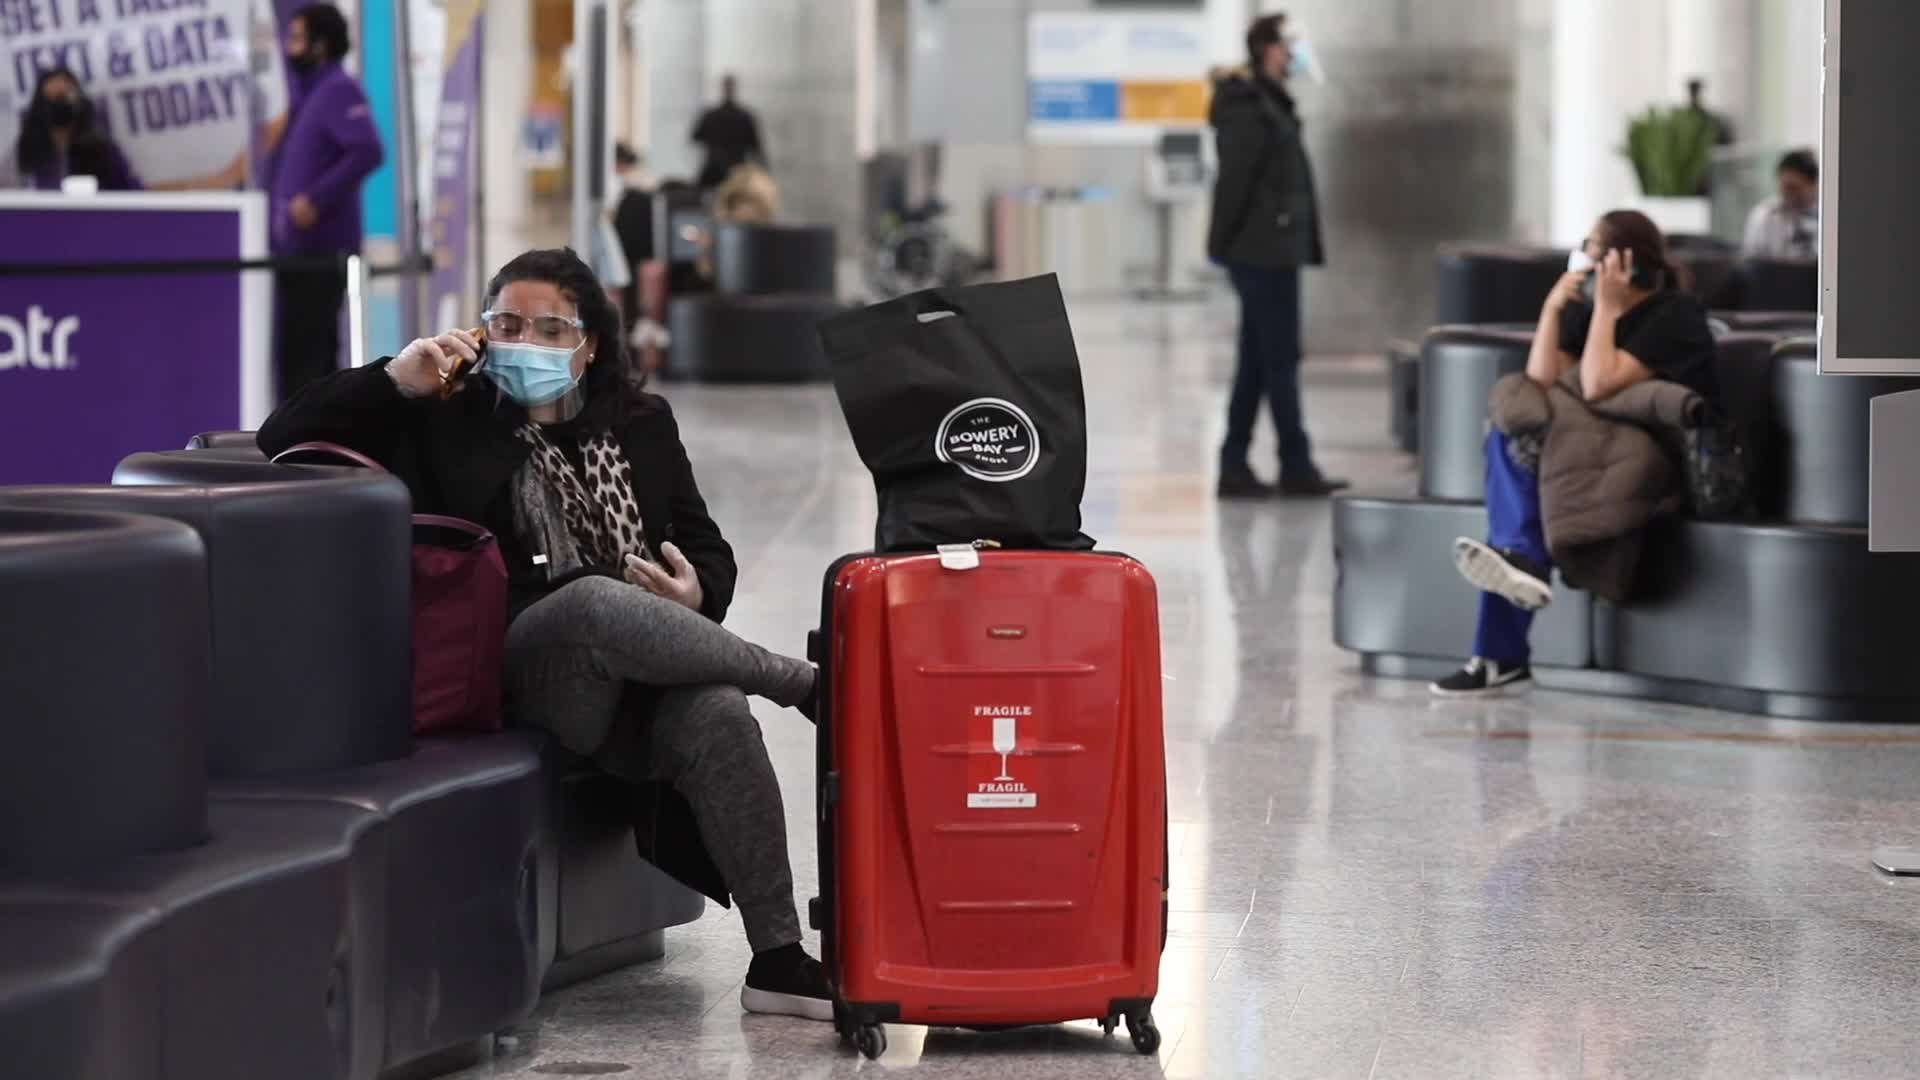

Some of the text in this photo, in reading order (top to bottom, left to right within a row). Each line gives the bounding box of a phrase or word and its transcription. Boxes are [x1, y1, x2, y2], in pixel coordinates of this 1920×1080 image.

[108, 30, 134, 78] &
[970, 417, 990, 425] THE
[950, 424, 1018, 444] BOWERY
[974, 706, 1032, 716] FRAGILE
[978, 783, 1027, 793] FRAGIL
